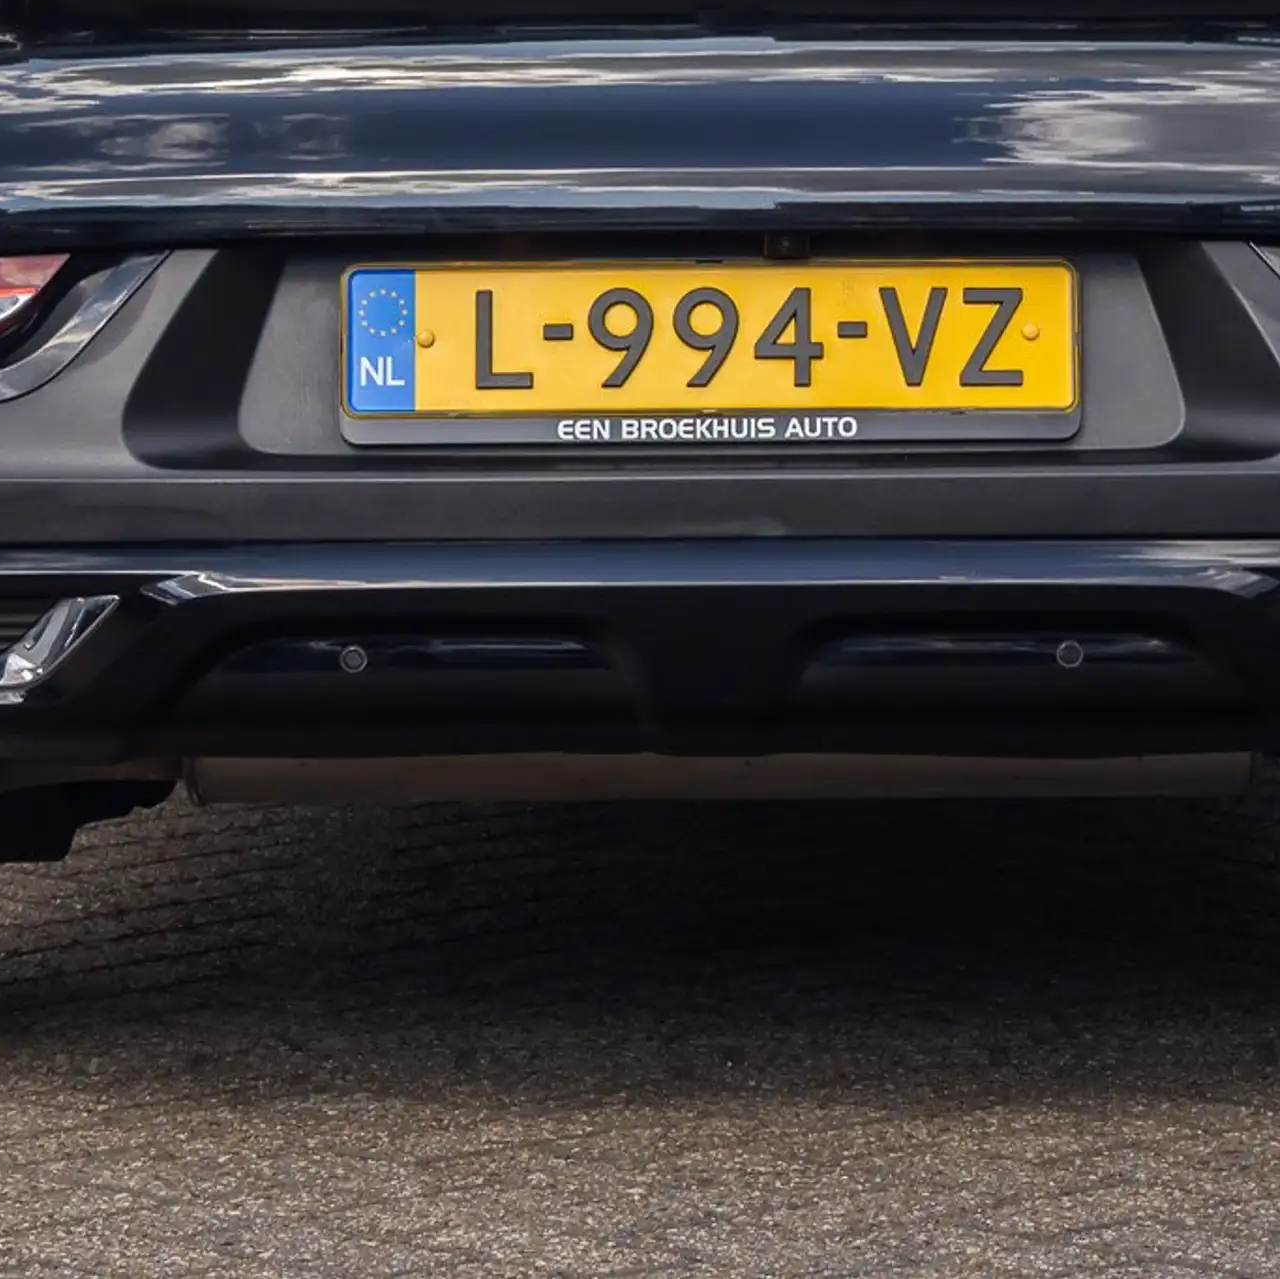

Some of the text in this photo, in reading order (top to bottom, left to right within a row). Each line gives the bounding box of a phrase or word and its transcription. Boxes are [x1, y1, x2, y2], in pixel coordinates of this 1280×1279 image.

[474, 286, 1025, 392] L-994-VZ
[360, 356, 406, 387] NL
[557, 416, 858, 441] EEN BROEKHUIS AUTO
